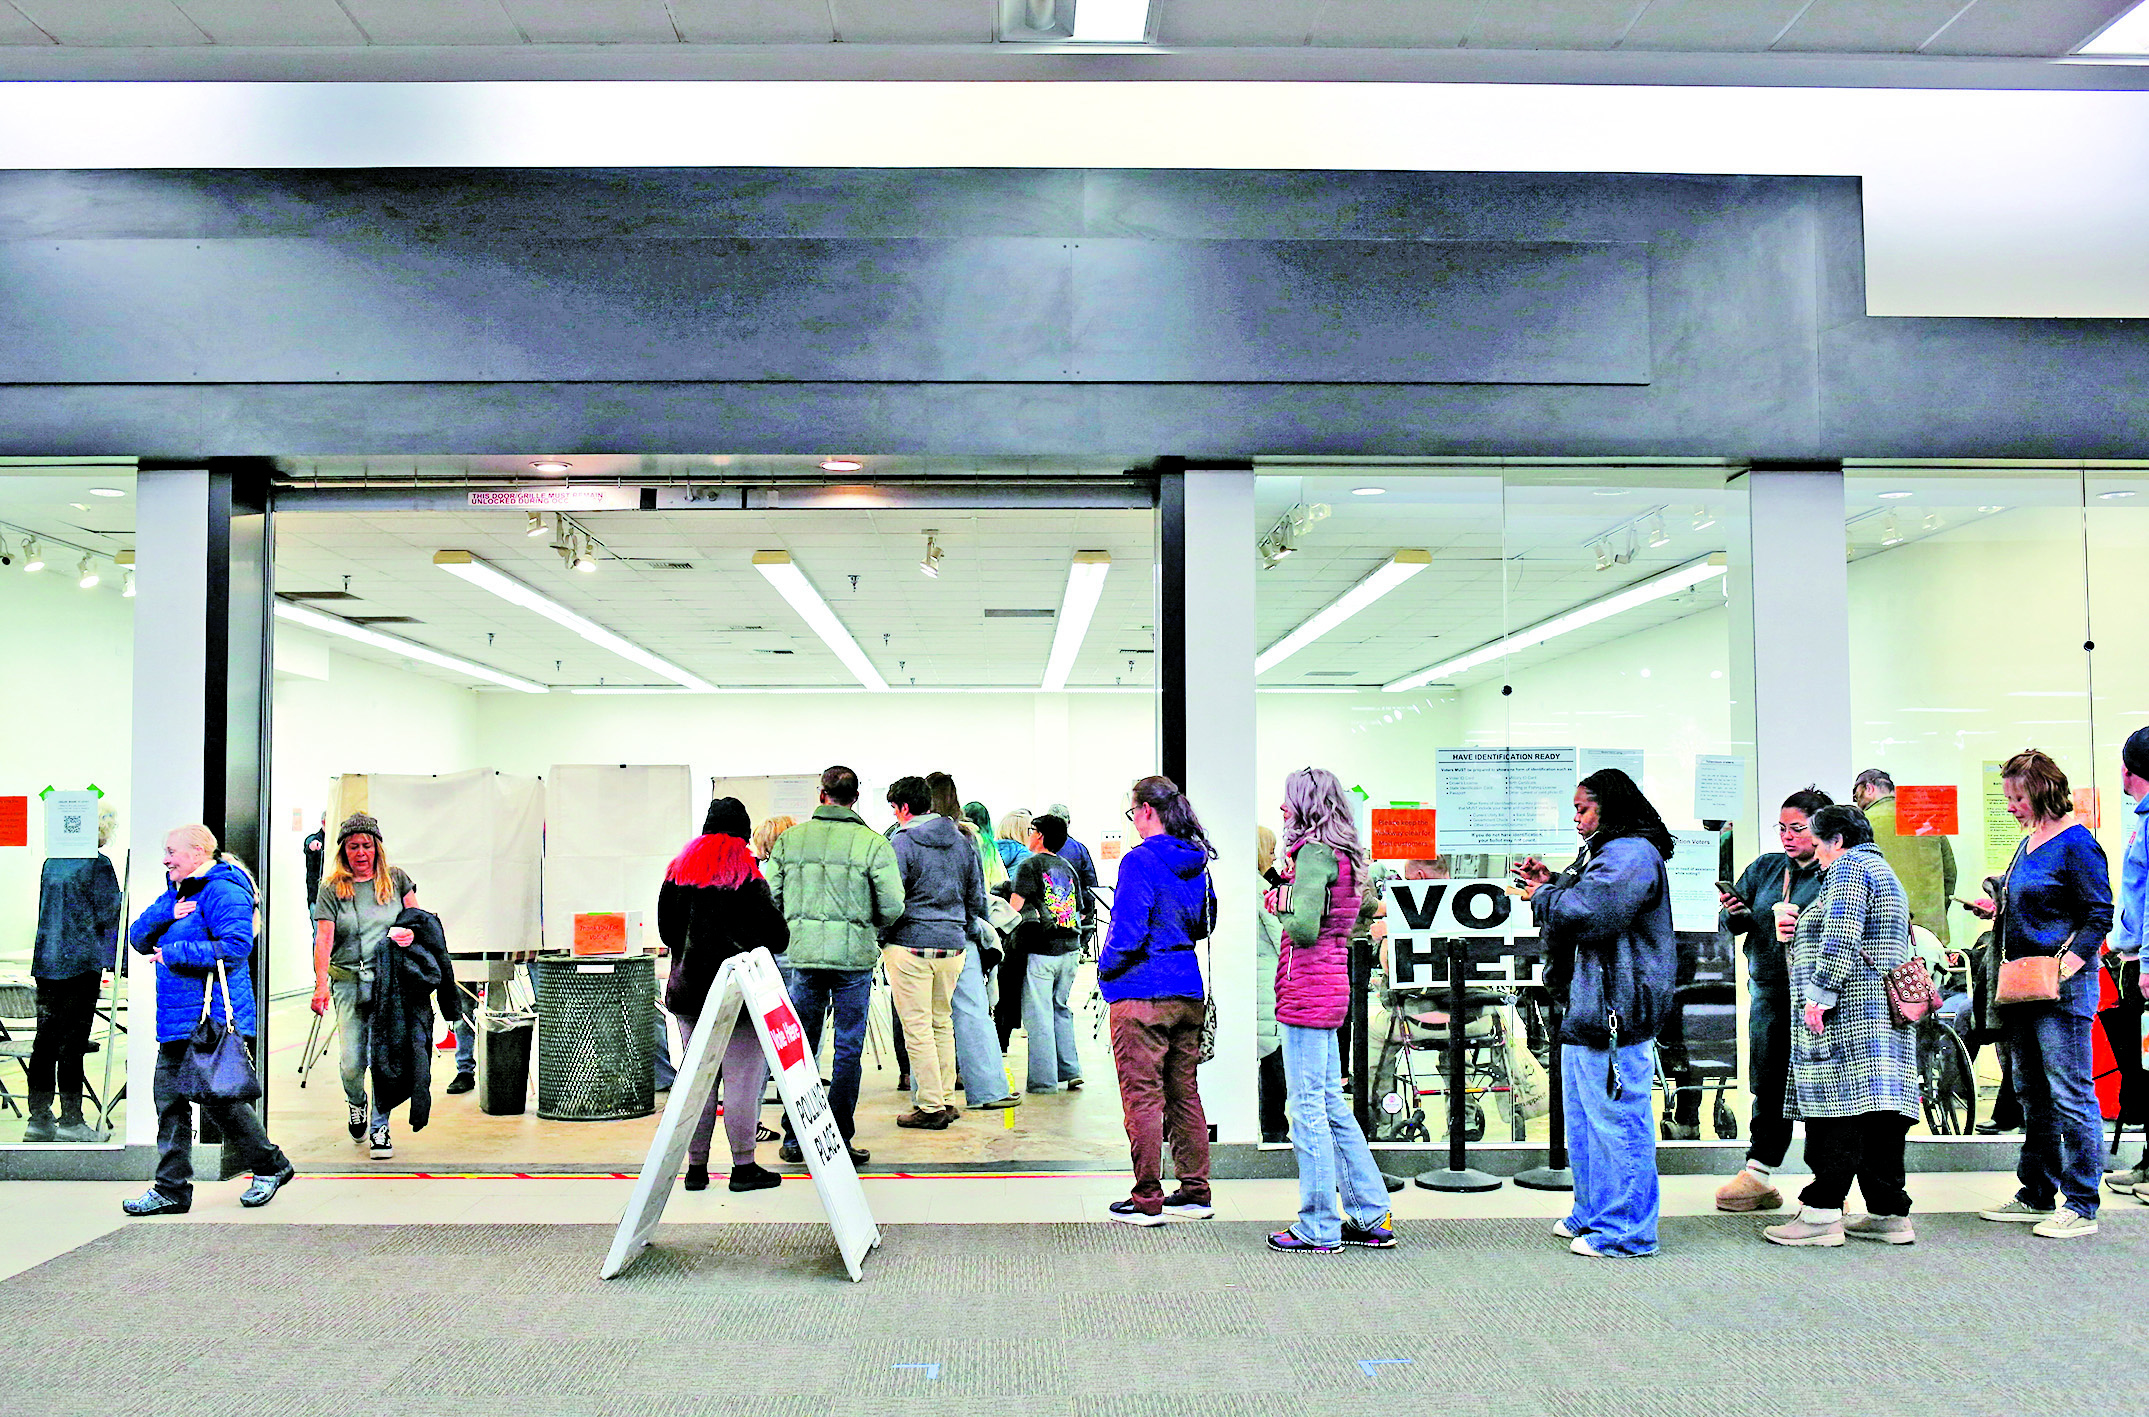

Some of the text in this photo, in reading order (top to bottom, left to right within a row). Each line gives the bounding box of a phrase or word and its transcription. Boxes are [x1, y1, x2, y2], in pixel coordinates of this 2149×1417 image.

[770, 1021, 801, 1051] Vote Here
[795, 1082, 828, 1129] POLLING
[814, 1122, 841, 1166] PLACE
